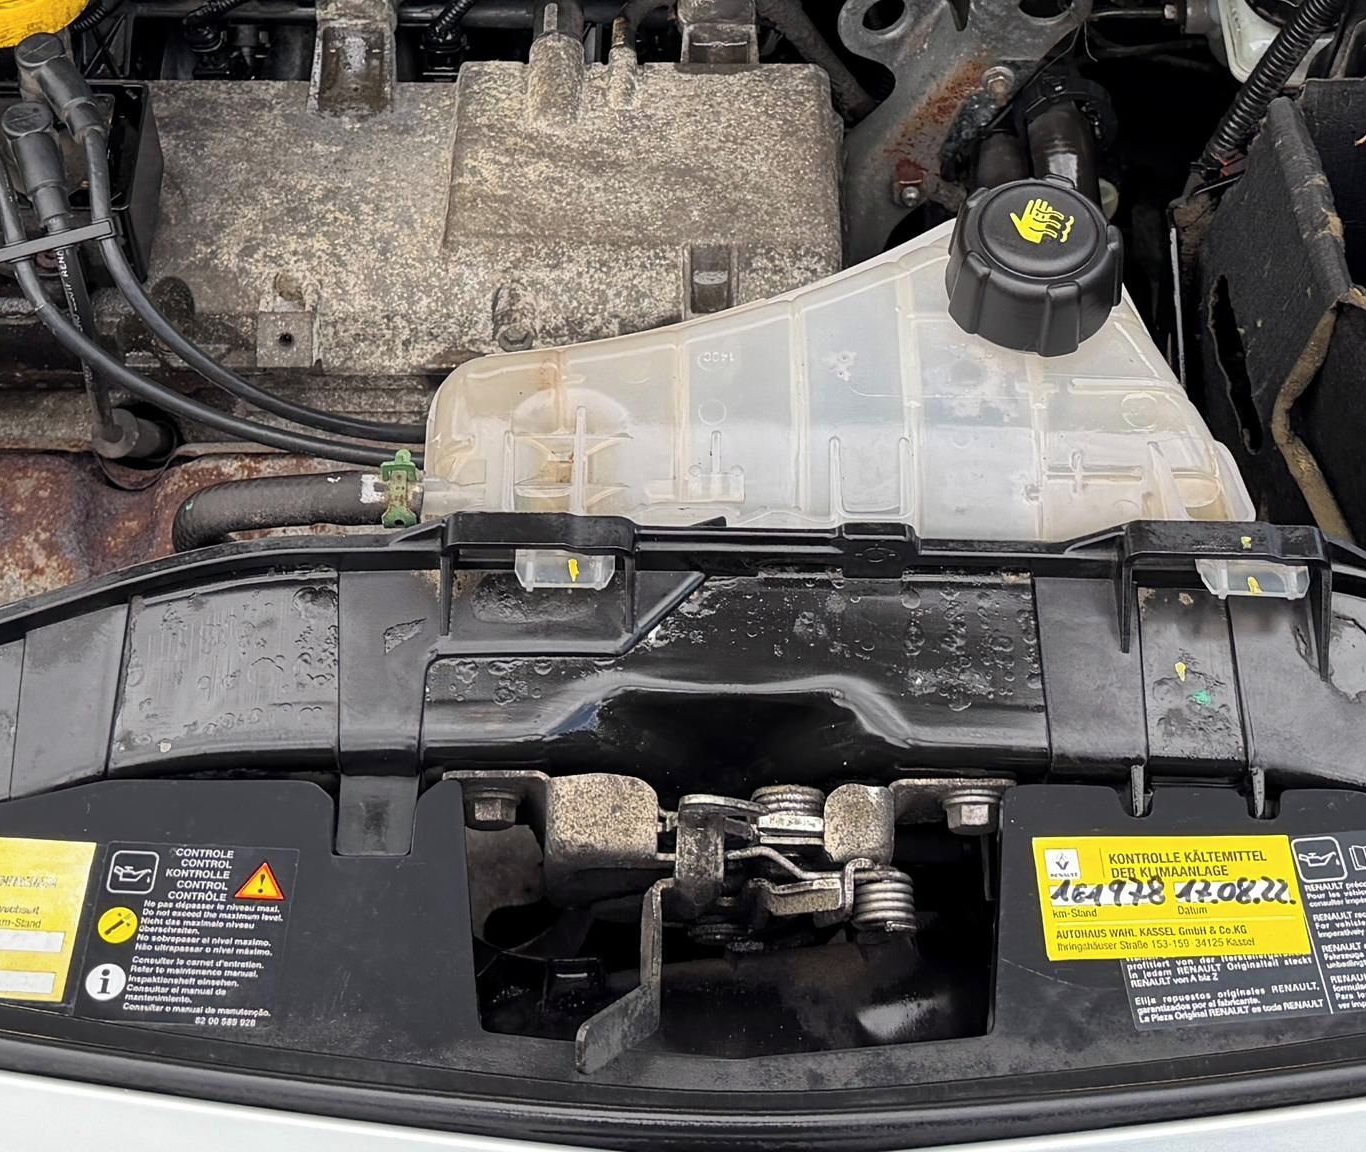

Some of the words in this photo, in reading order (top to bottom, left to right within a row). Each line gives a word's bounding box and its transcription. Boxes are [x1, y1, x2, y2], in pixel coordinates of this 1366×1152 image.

[176, 848, 234, 859] CONTROLE
[1108, 852, 1181, 865] KONTROLLE
[1184, 850, 1267, 863] KÄLTEMITTEL
[181, 859, 232, 869] CONTROL
[166, 869, 230, 879] KONTROLLE
[1111, 866, 1136, 879] DER
[1140, 865, 1229, 878] KLIMAANLAGE
[176, 880, 228, 890] CONTROL
[1304, 882, 1343, 892] RENAULT
[168, 890, 227, 901] CONTRÔLE
[143, 908, 154, 916] Do
[1052, 908, 1097, 919] km-Stand
[1177, 905, 1208, 916] Datum
[141, 917, 163, 925] Nicht
[1313, 912, 1352, 922] RENAULT
[137, 933, 149, 941] No
[1056, 929, 1107, 939] AUTOHAUS
[1140, 927, 1175, 937] KASSEL
[1179, 926, 1206, 936] GmbH
[1209, 926, 1218, 935] &
[1195, 938, 1224, 947] 34125
[1321, 942, 1361, 953] RENAULT
[1177, 963, 1221, 975] RENAULT
[1131, 977, 1171, 988] RENAULT
[1209, 1005, 1249, 1018] RENAULT
[1283, 999, 1323, 1011] RENAULT
